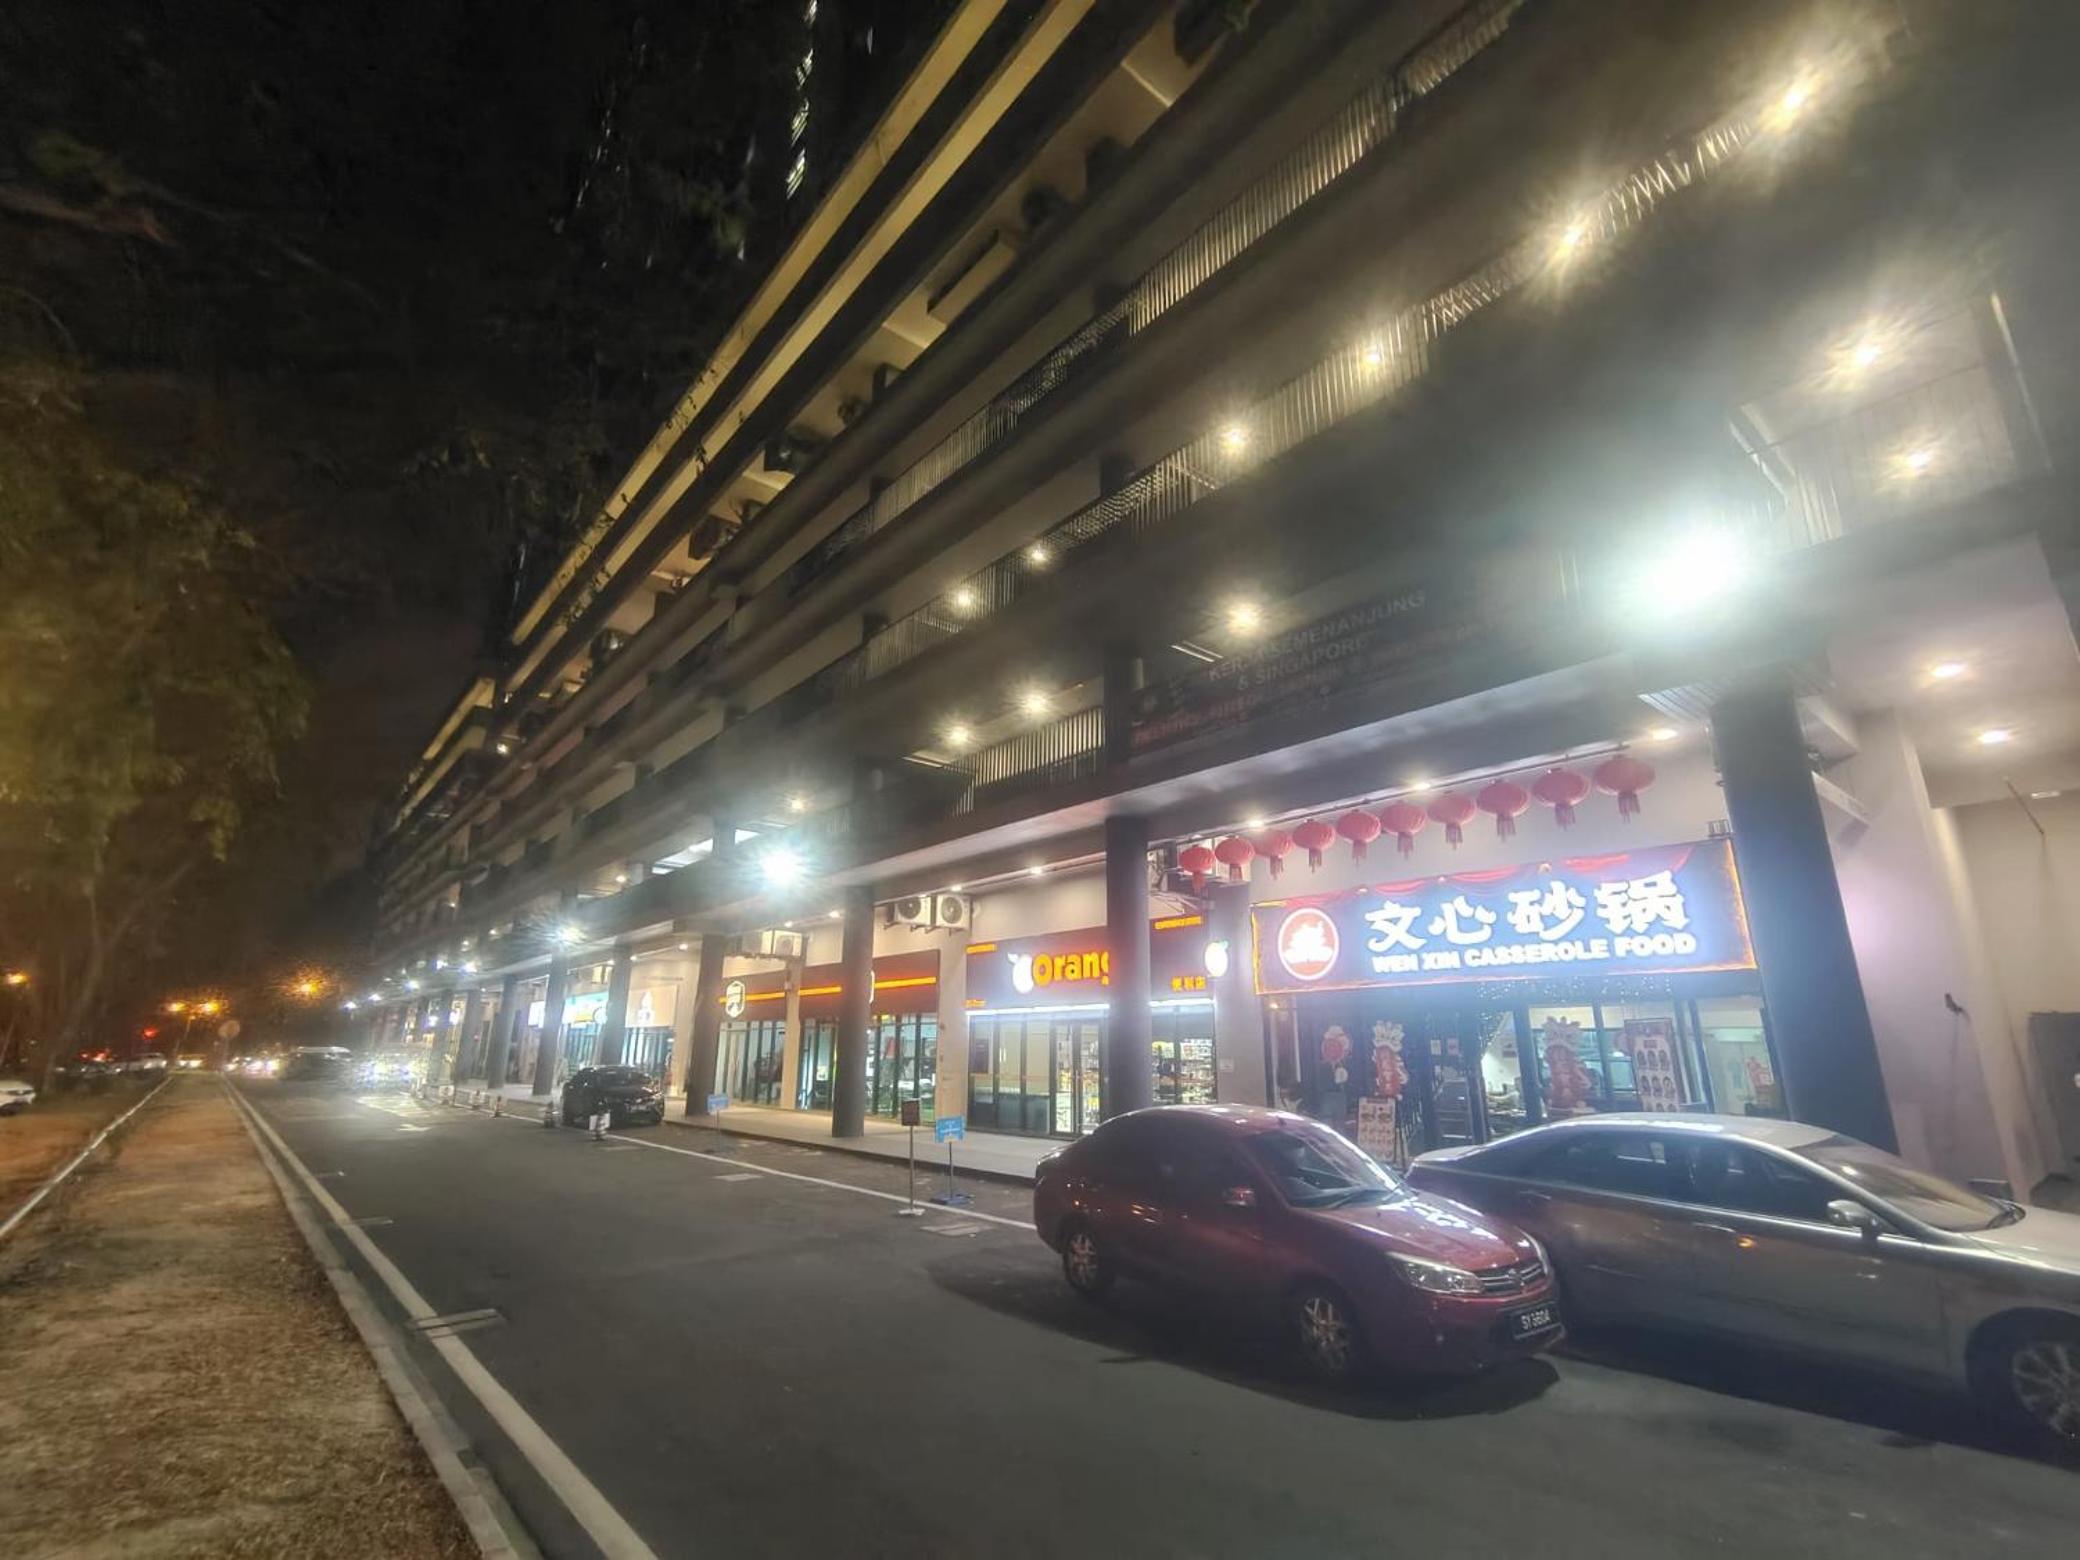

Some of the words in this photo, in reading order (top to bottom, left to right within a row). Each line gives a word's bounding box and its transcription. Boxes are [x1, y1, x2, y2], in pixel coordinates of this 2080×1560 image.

[1365, 870, 1690, 952] 文心砂锅
[1372, 954, 1419, 973] WEN
[1422, 951, 1461, 970] XIN
[1464, 938, 1610, 967] CASSEROLE
[1614, 932, 1696, 957] FOOD
